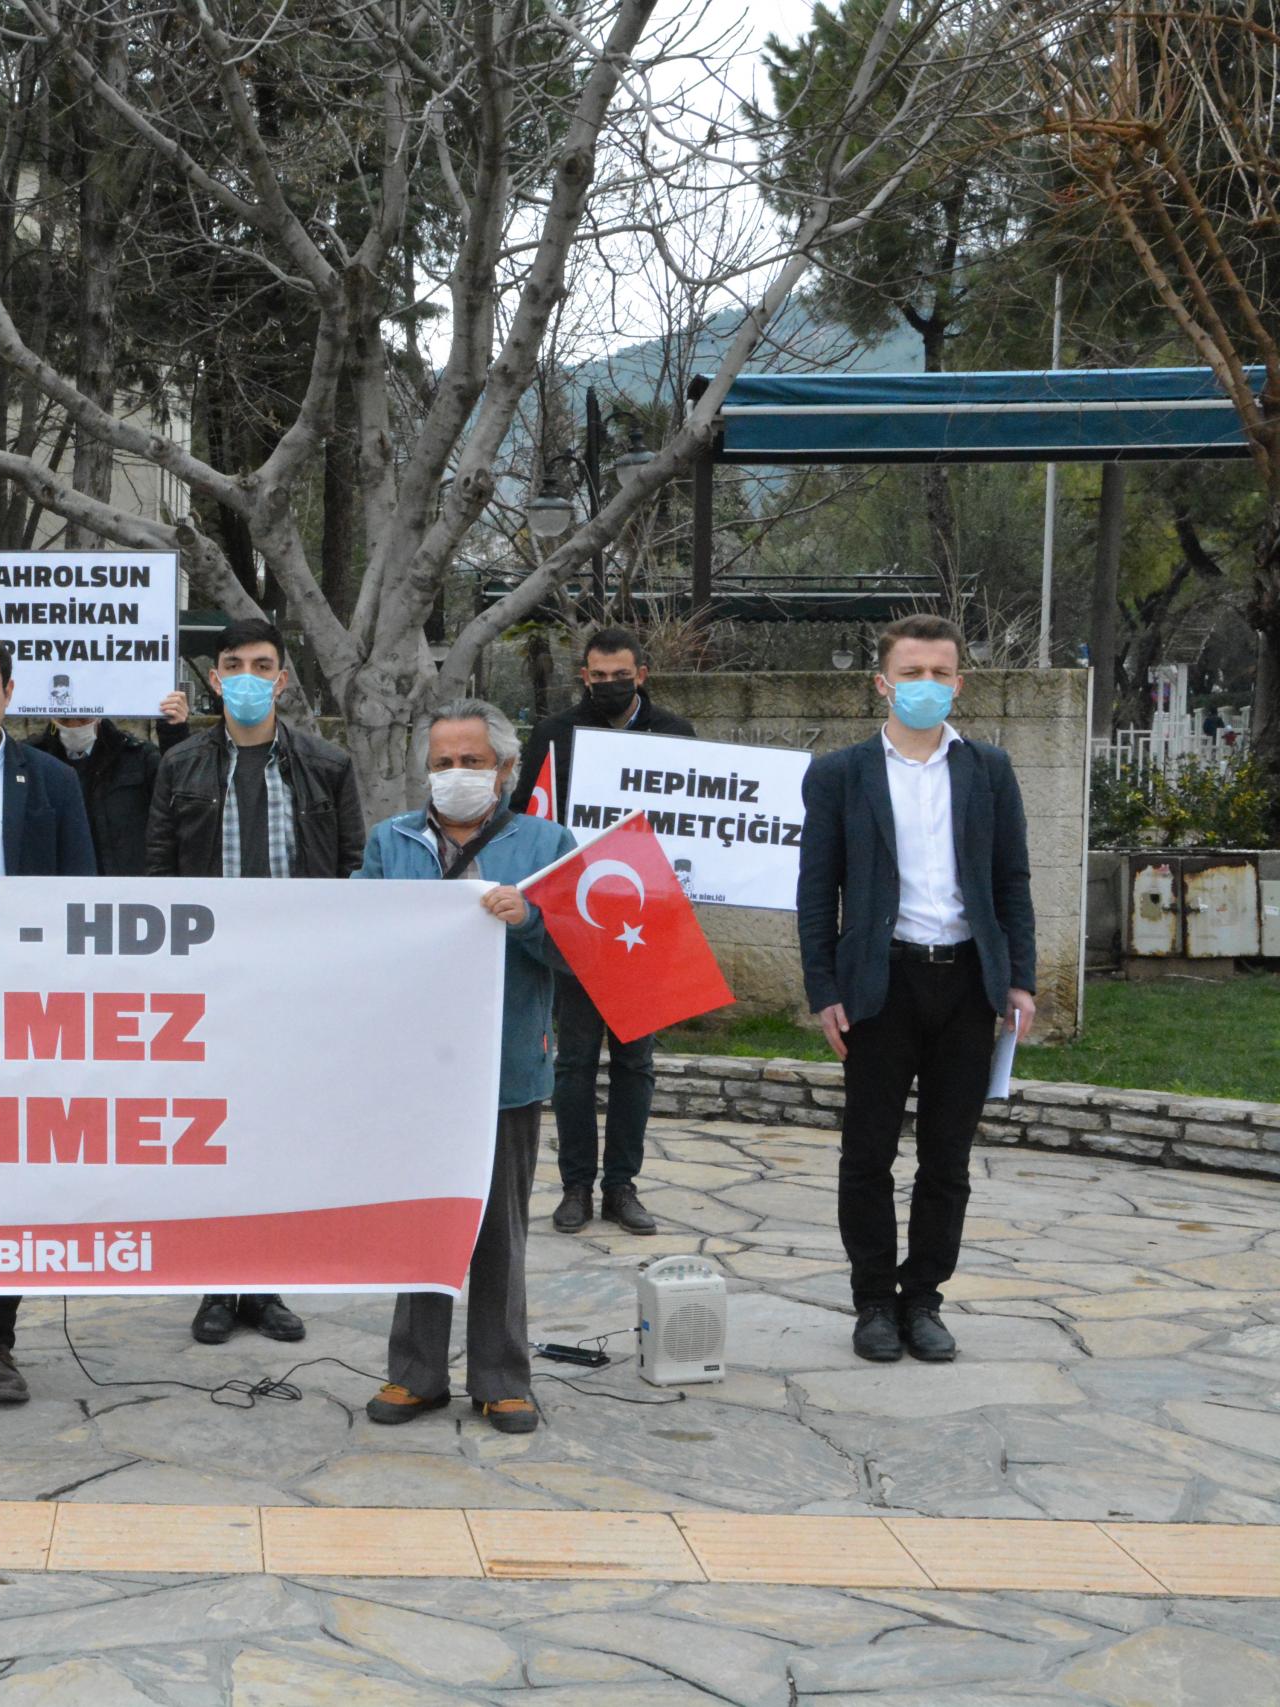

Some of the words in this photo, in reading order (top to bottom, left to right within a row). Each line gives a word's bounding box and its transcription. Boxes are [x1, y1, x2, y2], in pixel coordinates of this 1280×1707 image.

[1, 633, 170, 662] PERYALİZMİ
[619, 767, 760, 804] HEPİMİZ
[19, 927, 44, 942] -
[66, 903, 216, 956] HDP
